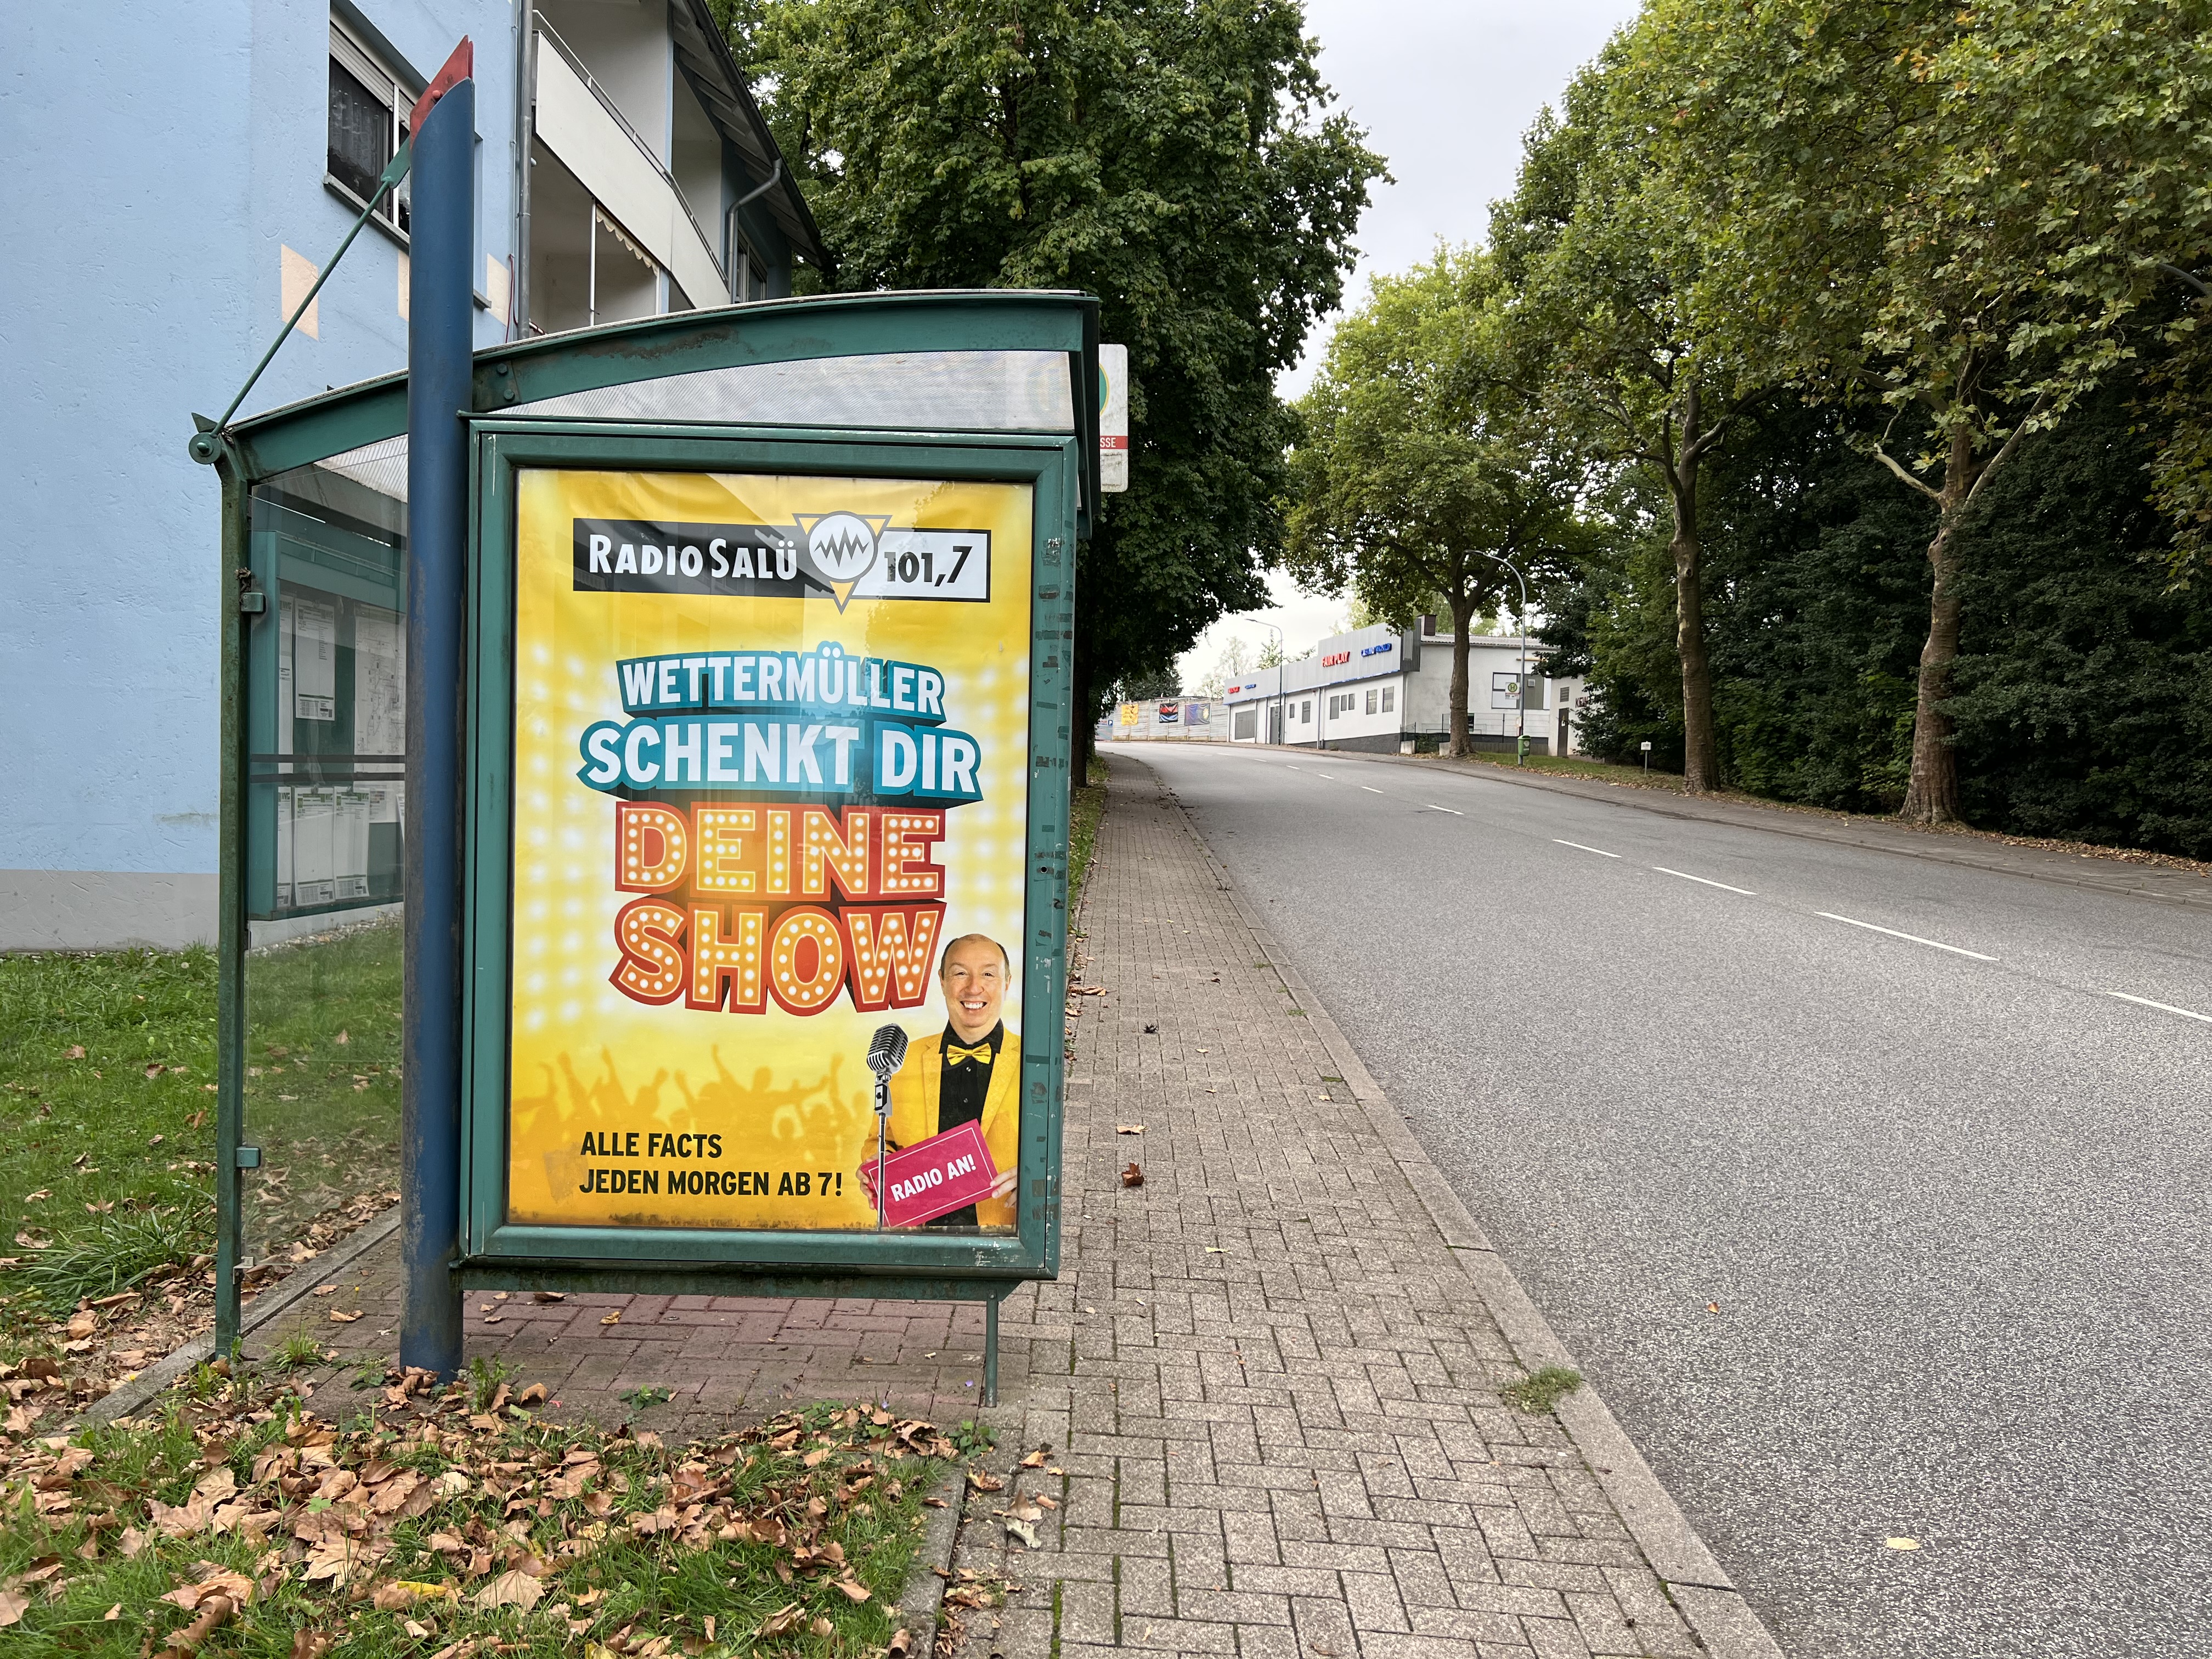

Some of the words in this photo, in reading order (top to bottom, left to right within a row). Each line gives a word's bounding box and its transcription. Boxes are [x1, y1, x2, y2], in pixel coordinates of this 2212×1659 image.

[1100, 437, 1116, 447] SSE
[590, 534, 703, 578] RADIO
[709, 537, 798, 580] SALÜ
[884, 545, 973, 587] 101,7
[622, 646, 942, 715] WETTERMÜLLER
[1322, 655, 1335, 667] FAIR
[1334, 651, 1350, 664] PLAY
[587, 722, 860, 786] SCHENKT
[881, 733, 978, 794] DIR
[620, 807, 940, 895] DEINE
[617, 905, 939, 1009] SHOW
[580, 1131, 639, 1156] ALLE
[648, 1133, 722, 1159] FACTS
[579, 1169, 659, 1194] JEDEN
[668, 1170, 769, 1196] MORGEN
[777, 1172, 811, 1197] AB
[817, 1172, 842, 1197] 7!
[890, 1163, 943, 1202] RADIO
[947, 1154, 977, 1182] AN!
